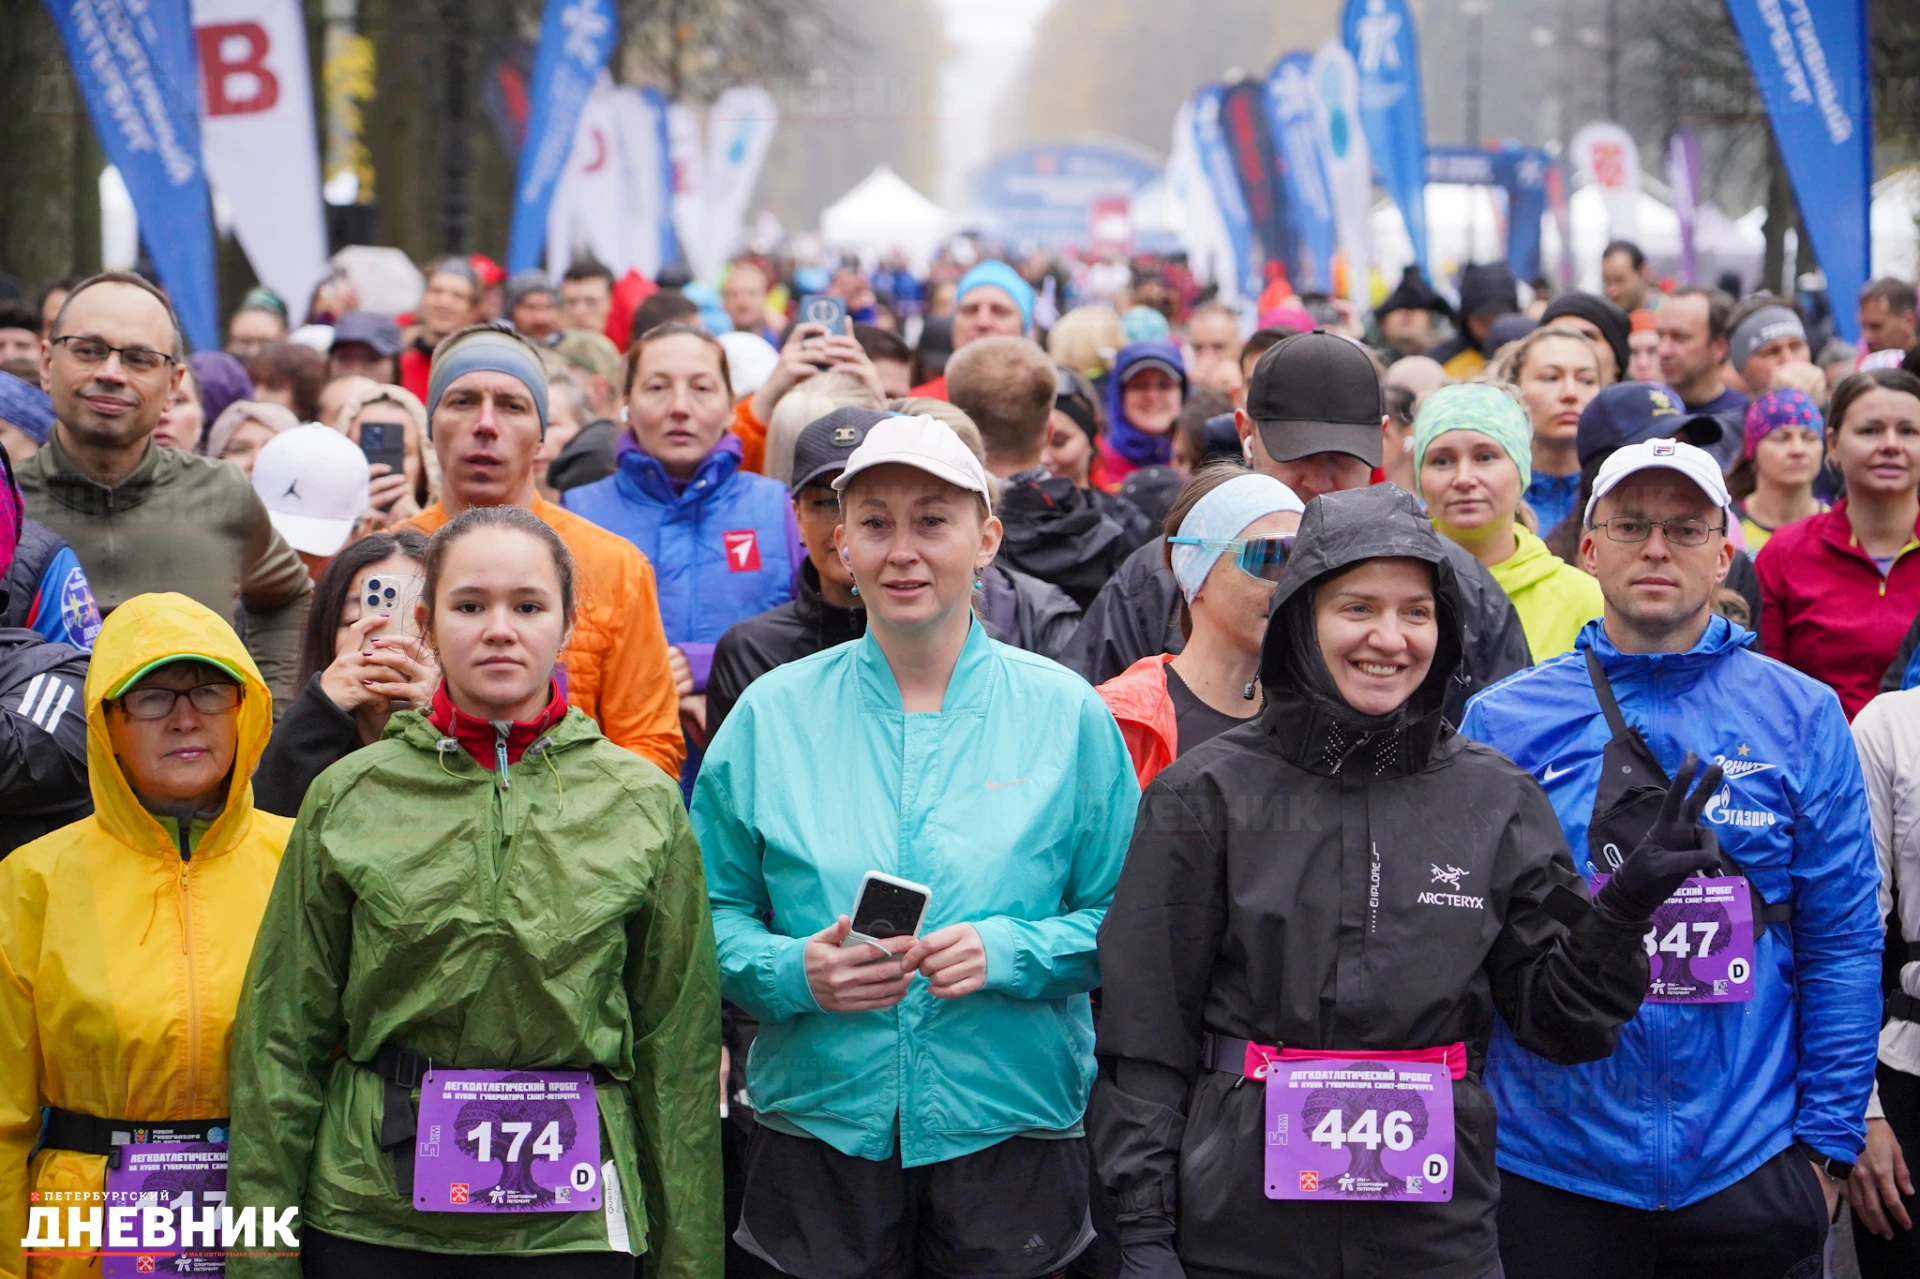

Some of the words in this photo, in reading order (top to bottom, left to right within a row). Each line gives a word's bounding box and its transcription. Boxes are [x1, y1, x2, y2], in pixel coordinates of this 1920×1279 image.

[1729, 809, 1777, 827] ГАЗПРО
[1673, 885, 1703, 896] ЕСКИЙ
[1706, 886, 1734, 896] ПРОБЕГ
[1417, 892, 1484, 909] ARC'TERYX
[1732, 963, 1745, 979] D
[1290, 1069, 1396, 1081] ЛЕГКОАТЛЕТИЧЕСКИЙ
[1399, 1071, 1433, 1083] ПРОБЕГ
[444, 1079, 546, 1092] ЛЕГКОАТЛЕТИЧЕСКИЙ
[549, 1081, 578, 1092] ПРОБЕГ
[1288, 1081, 1299, 1089] НА
[1325, 1081, 1373, 1089] ГУБЕРНАТОРА
[442, 1092, 452, 1100] НА
[480, 1093, 525, 1101] ГУБЕРНАТОРА
[1311, 1109, 1414, 1152] 446
[467, 1120, 563, 1163] 174
[163, 1163, 209, 1171] ГУБЕРНАТОРА
[1428, 1161, 1442, 1177] D
[576, 1169, 590, 1185] D
[135, 1190, 228, 1230] 117
